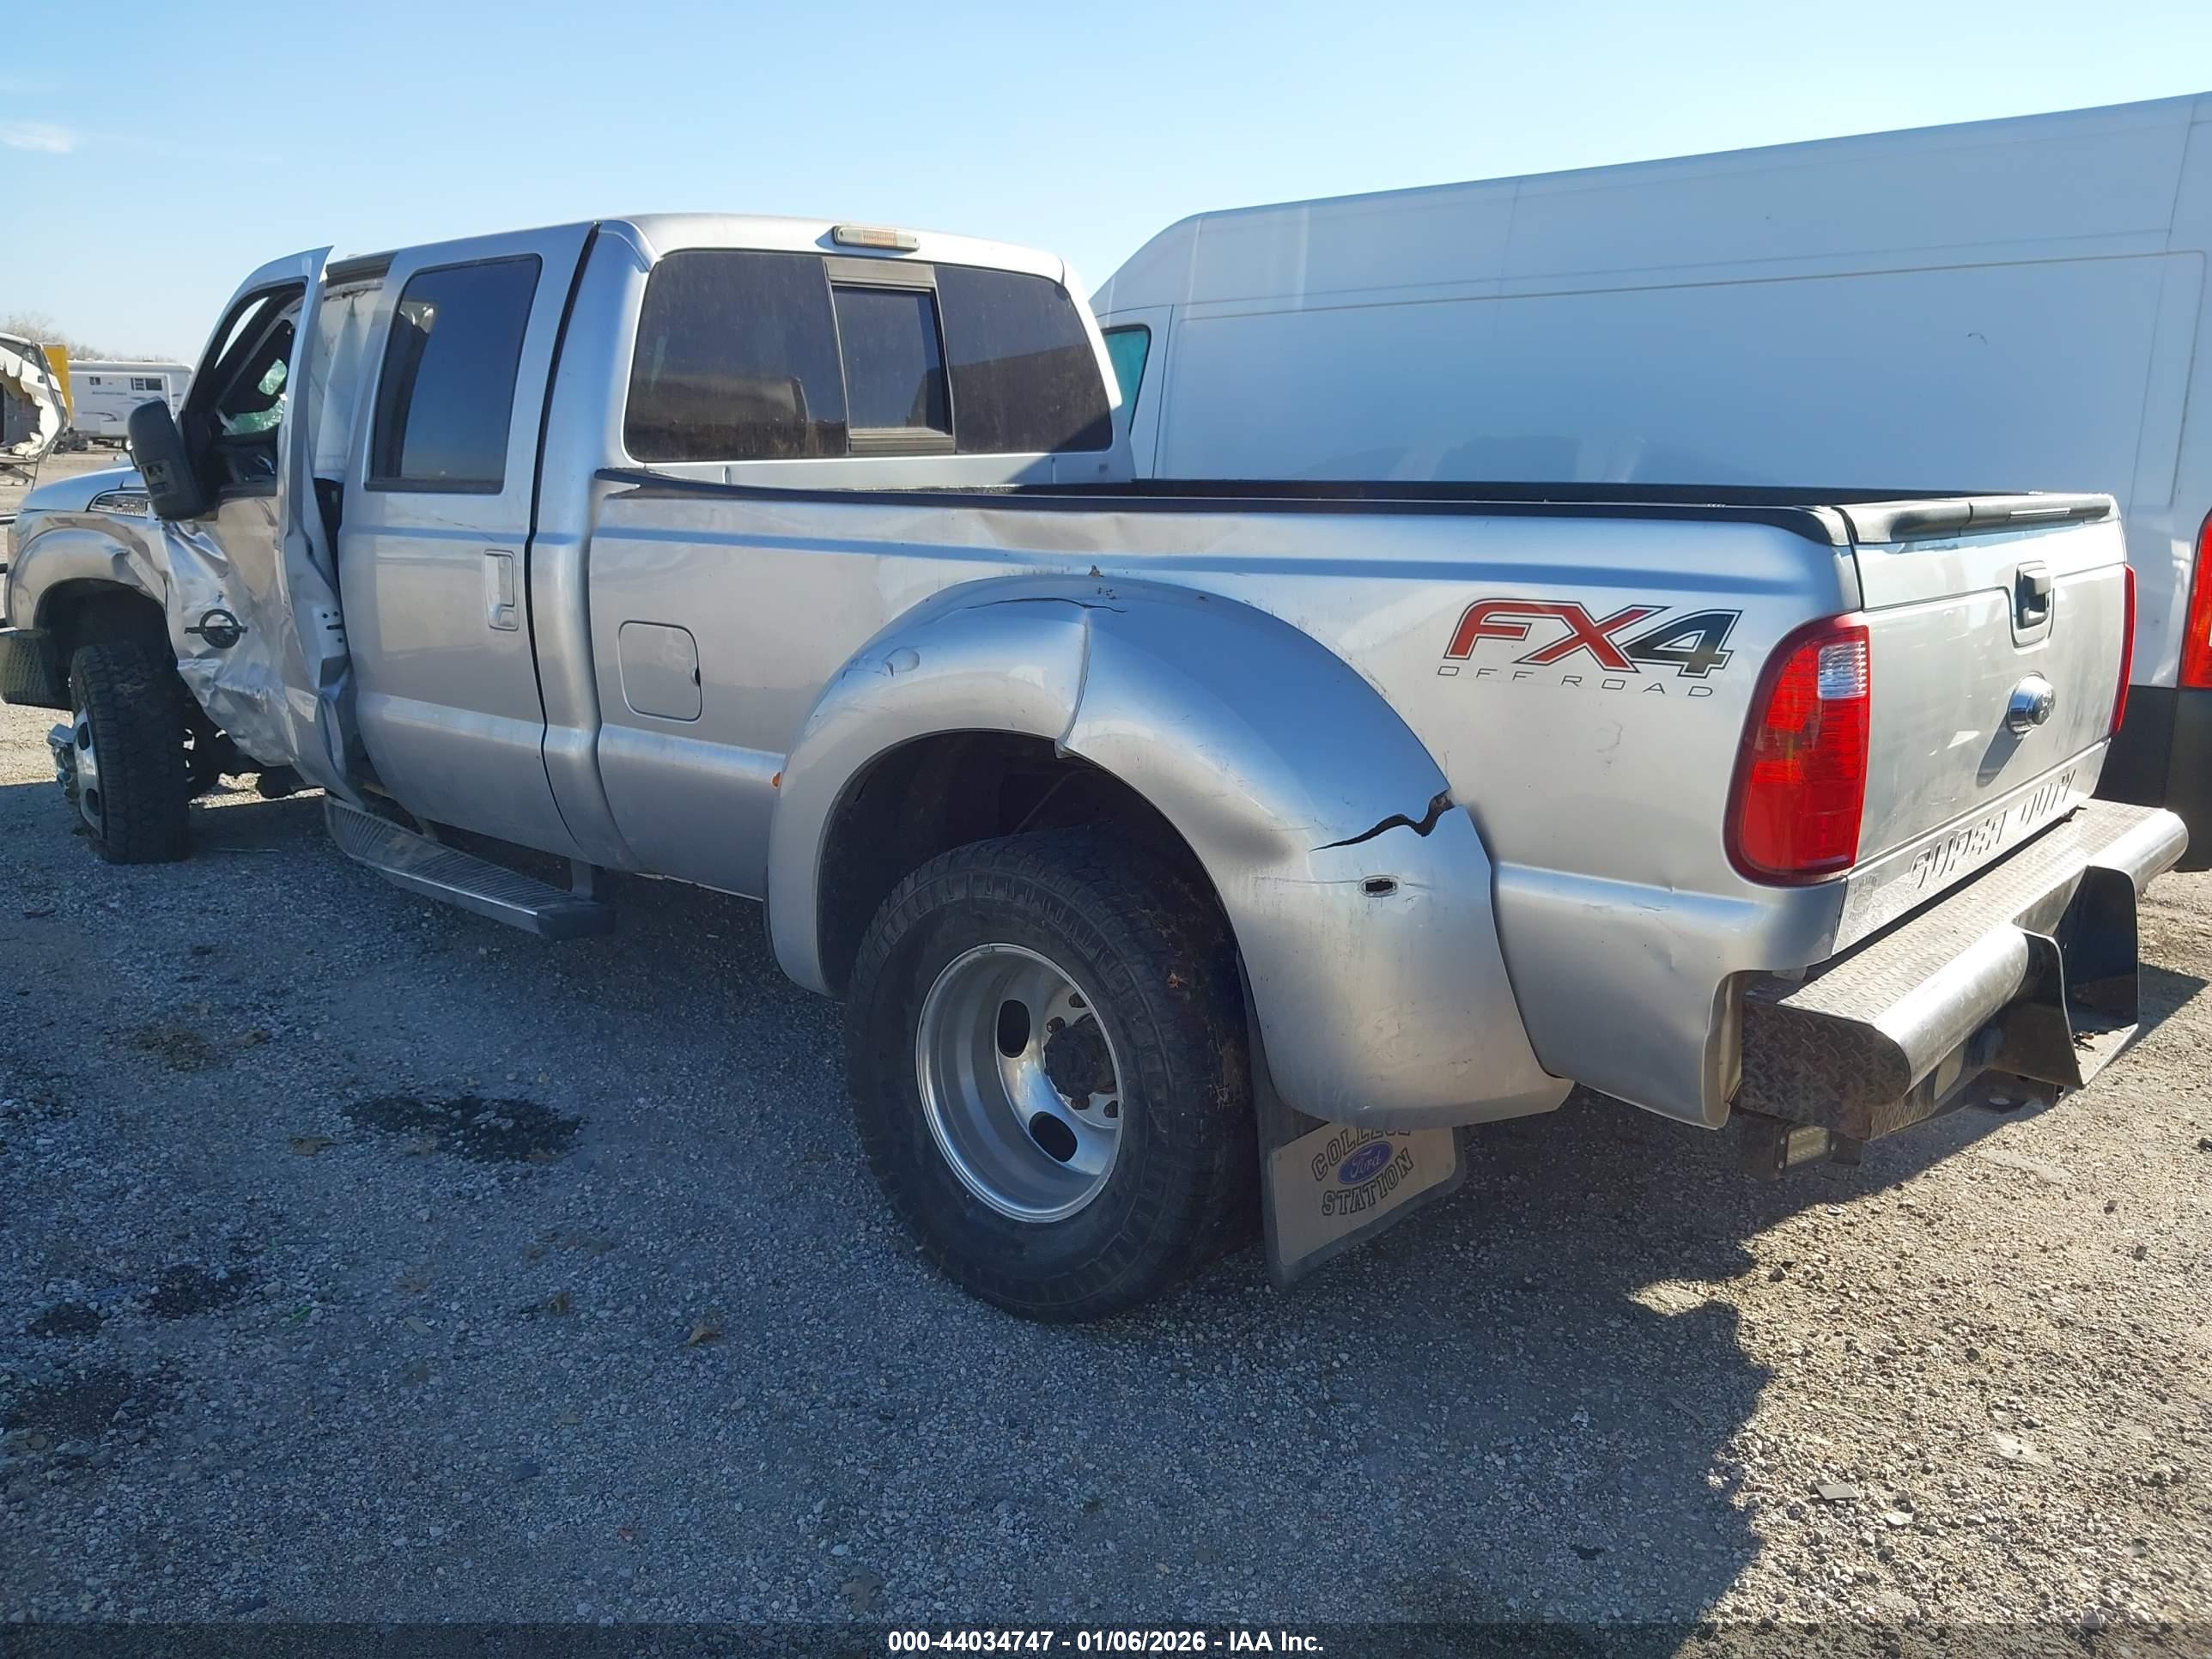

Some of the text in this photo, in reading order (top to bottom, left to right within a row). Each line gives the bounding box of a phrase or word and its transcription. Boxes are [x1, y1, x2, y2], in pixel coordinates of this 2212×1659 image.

[1443, 599, 1742, 678] FX4
[1437, 665, 1714, 697] OFF ROAD
[1311, 1127, 1411, 1182] COLL
[1322, 1146, 1414, 1216] STATION
